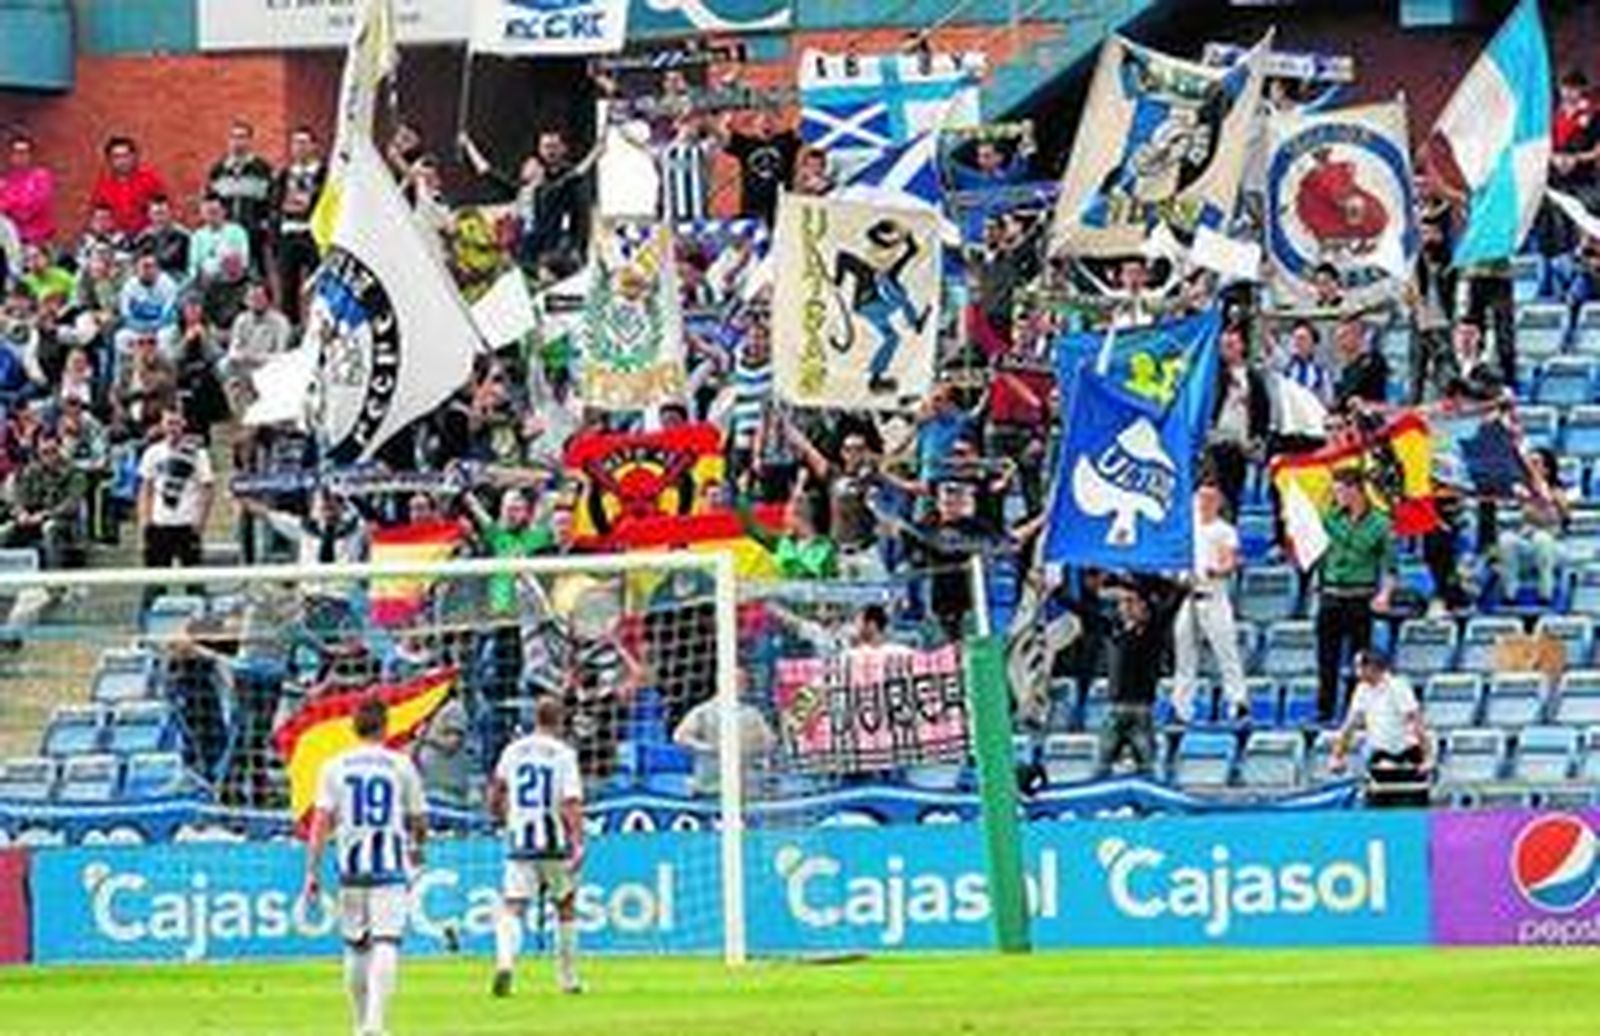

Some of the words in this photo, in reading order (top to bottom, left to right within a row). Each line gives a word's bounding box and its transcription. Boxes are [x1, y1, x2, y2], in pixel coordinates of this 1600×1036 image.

[344, 774, 394, 828] 19
[517, 762, 553, 808] 21
[84, 863, 336, 961] Cajaso
[775, 846, 1057, 945] Cajasl
[1098, 837, 1387, 937] Cajasol
